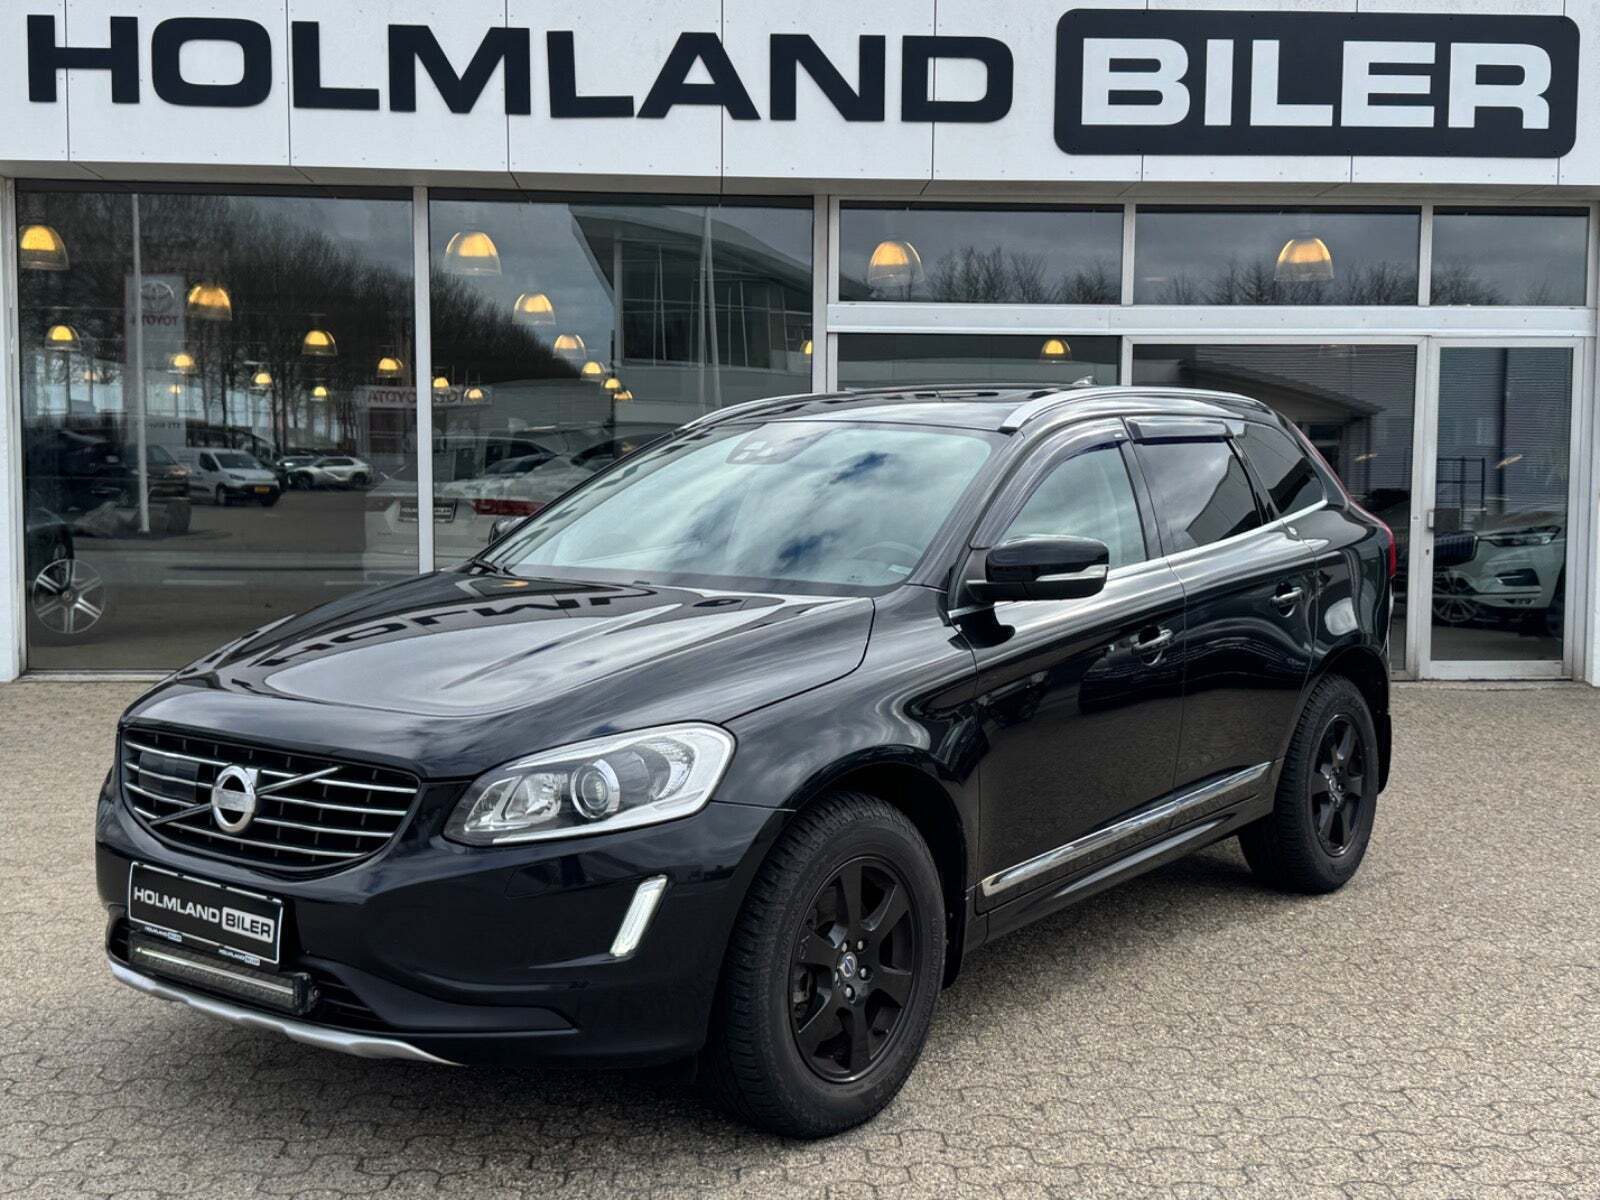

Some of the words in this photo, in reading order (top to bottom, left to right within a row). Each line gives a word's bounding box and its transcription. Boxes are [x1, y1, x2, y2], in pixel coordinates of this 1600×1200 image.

[27, 15, 1014, 123] HOLMLAND
[1081, 38, 1552, 130] BILER
[134, 886, 220, 923] HOLMLAND
[225, 913, 272, 938] BILER
